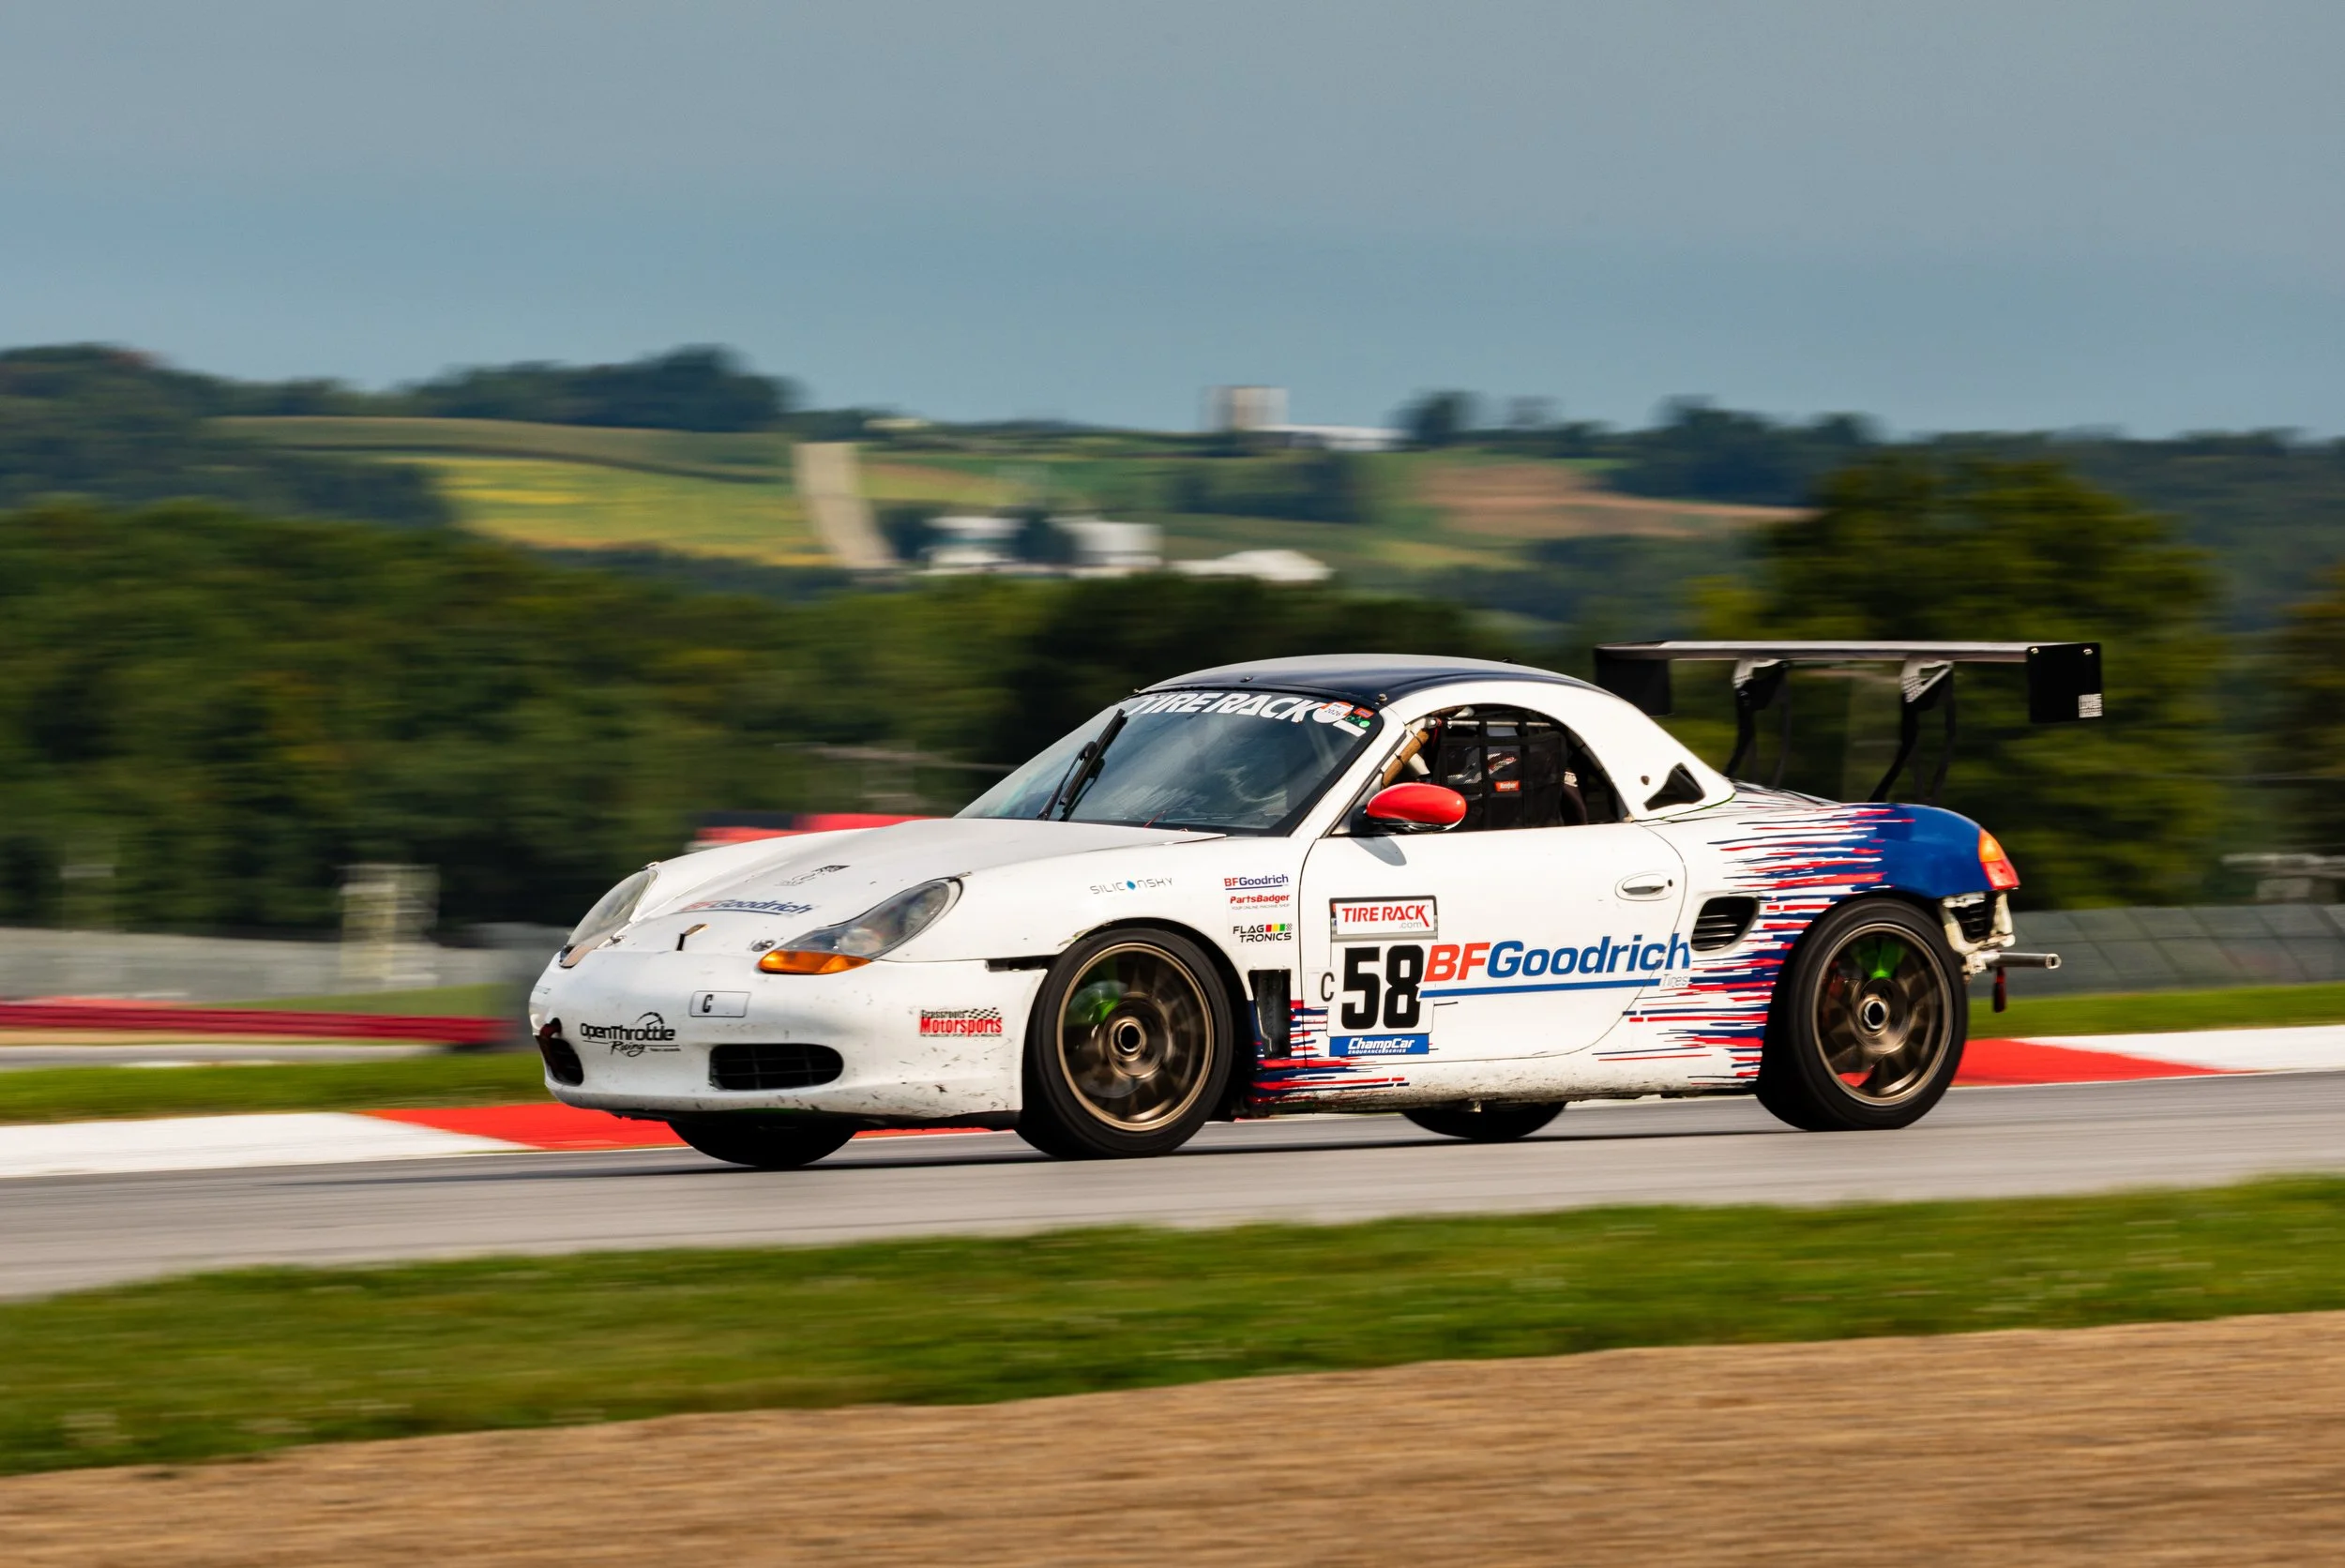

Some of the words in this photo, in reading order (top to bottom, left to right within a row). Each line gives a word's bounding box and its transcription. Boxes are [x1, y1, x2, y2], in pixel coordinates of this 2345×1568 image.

[1125, 693, 1224, 716] TIRE
[1202, 694, 1324, 723] RACK
[1223, 874, 1289, 887] BFGoodrich
[680, 899, 813, 914] BFGoodrich
[1230, 895, 1290, 904] PartsBadger
[1342, 907, 1379, 923] TIRE
[1382, 905, 1430, 927] RACK
[1233, 925, 1264, 934] FLAG
[1239, 932, 1292, 942] TRONICS
[1423, 932, 1691, 983] BFGoodrich
[1321, 972, 1335, 1003] C
[1341, 944, 1424, 1030] 58
[580, 1022, 676, 1041] OpenThrottle
[920, 1018, 1002, 1037] Motorsports
[1347, 1037, 1415, 1051] ChampCar
